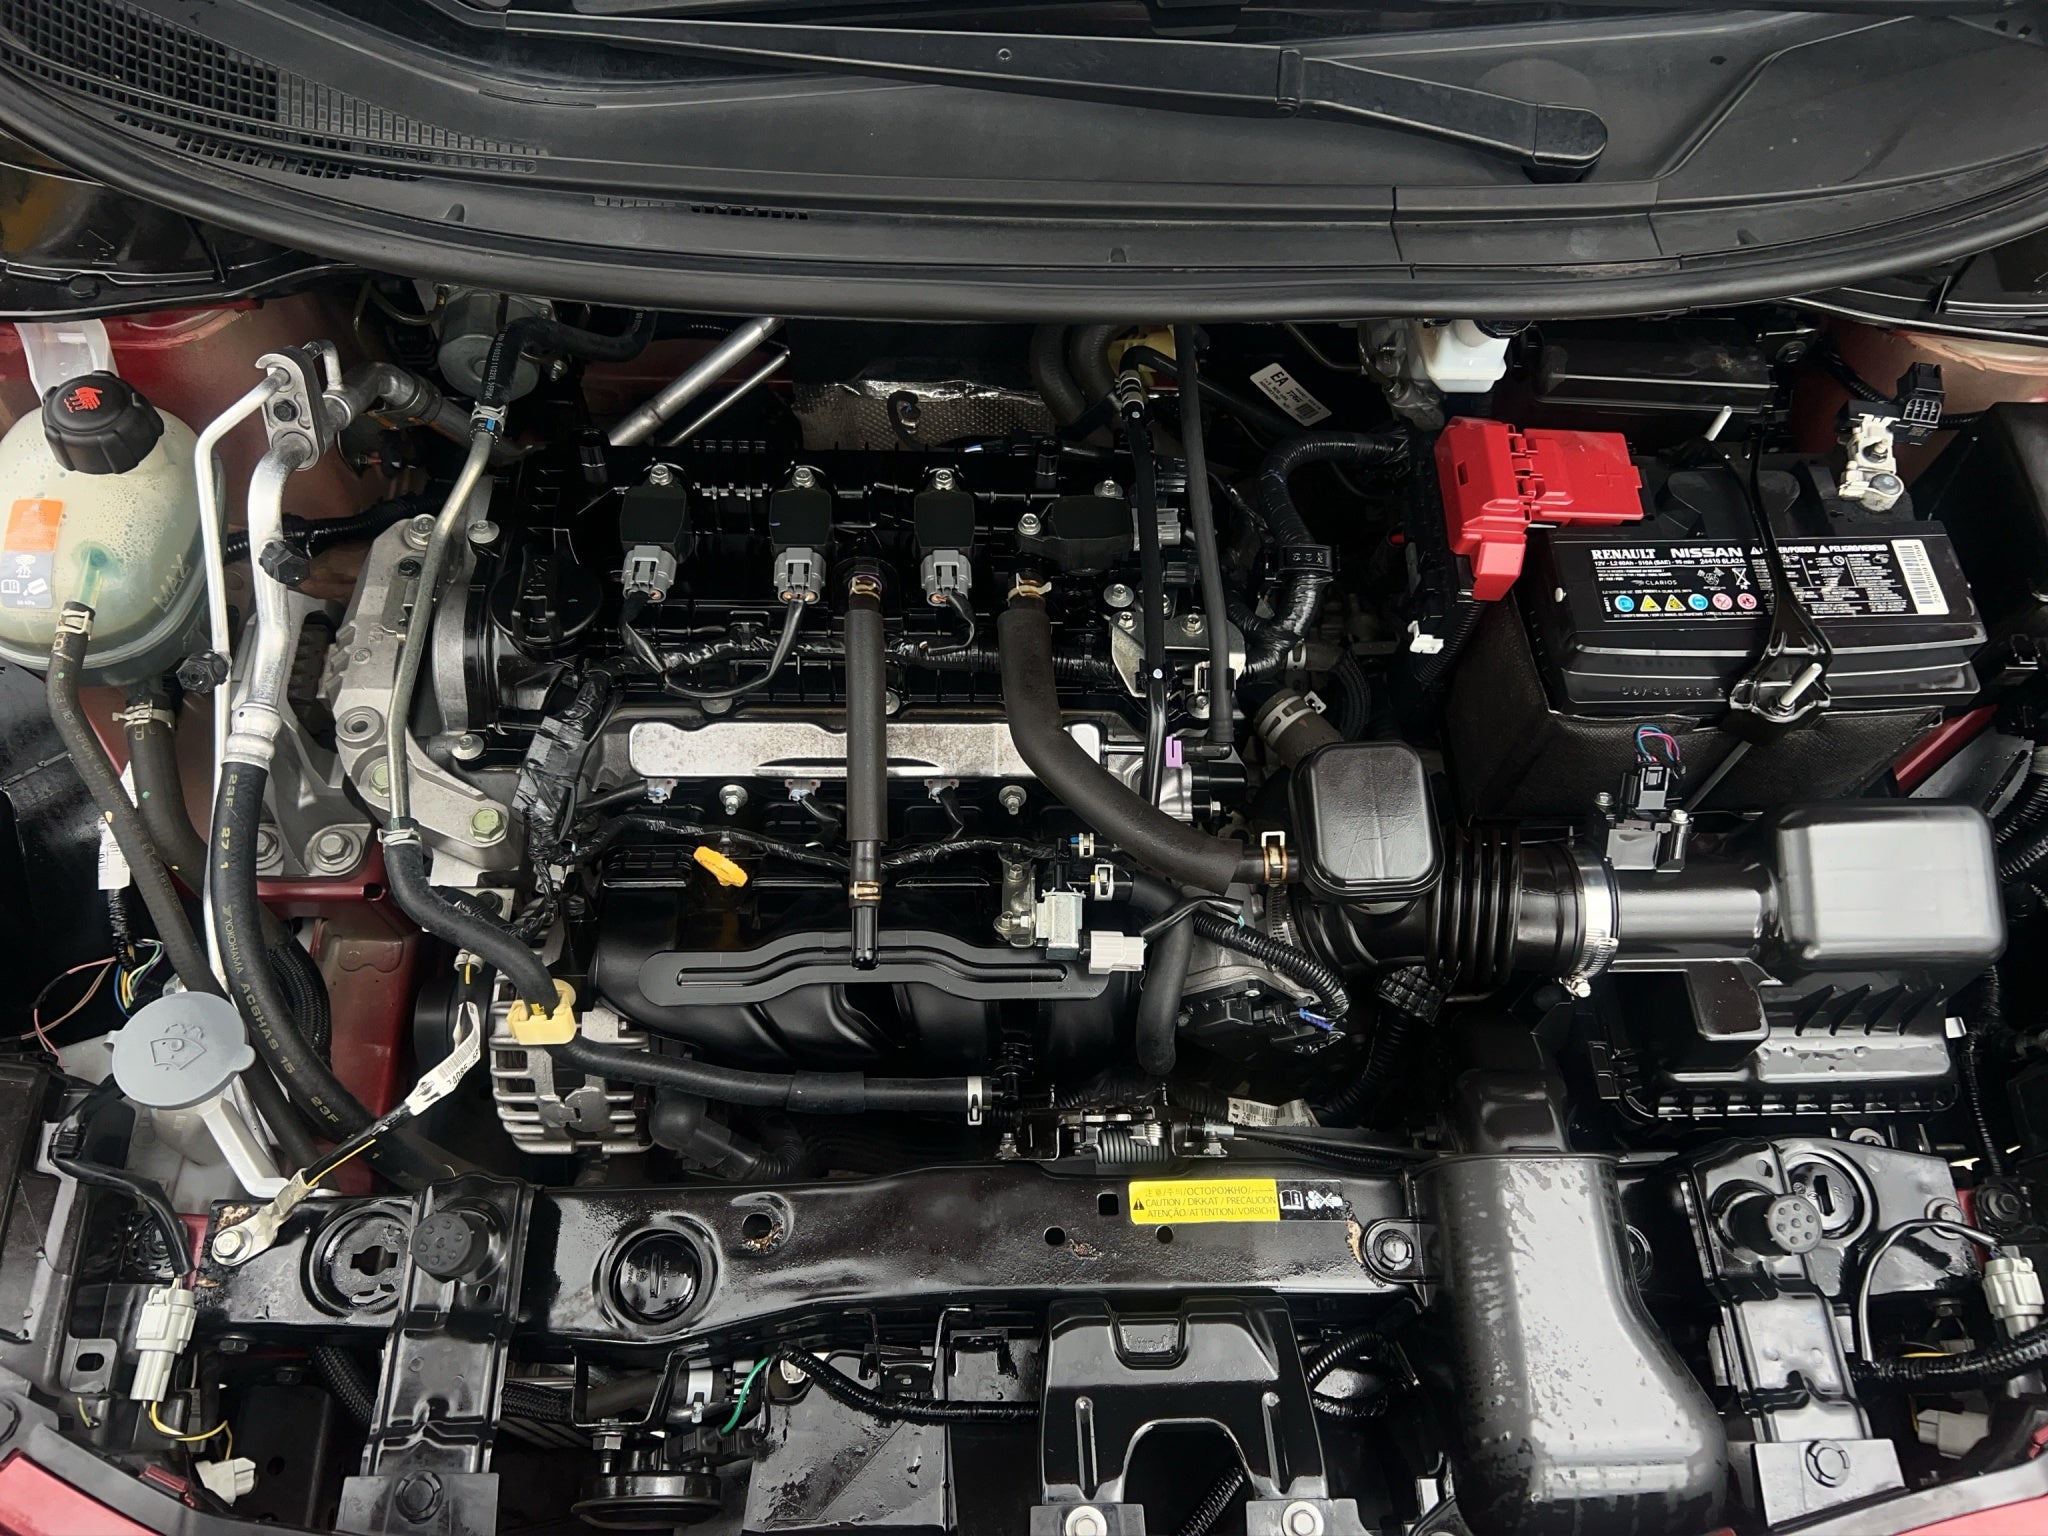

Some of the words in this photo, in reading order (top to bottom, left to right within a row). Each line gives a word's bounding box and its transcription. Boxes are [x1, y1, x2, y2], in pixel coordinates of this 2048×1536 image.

[1270, 371, 1289, 387] EA
[1591, 548, 1656, 560] RENAULT
[1670, 547, 1744, 559] NISSAN
[152, 553, 192, 613] MAX
[225, 773, 239, 808] 23F
[221, 826, 231, 850] 27
[223, 917, 245, 975] YOKOHAMA
[310, 1095, 340, 1123] 23F
[1145, 1197, 1181, 1207] CAUTION
